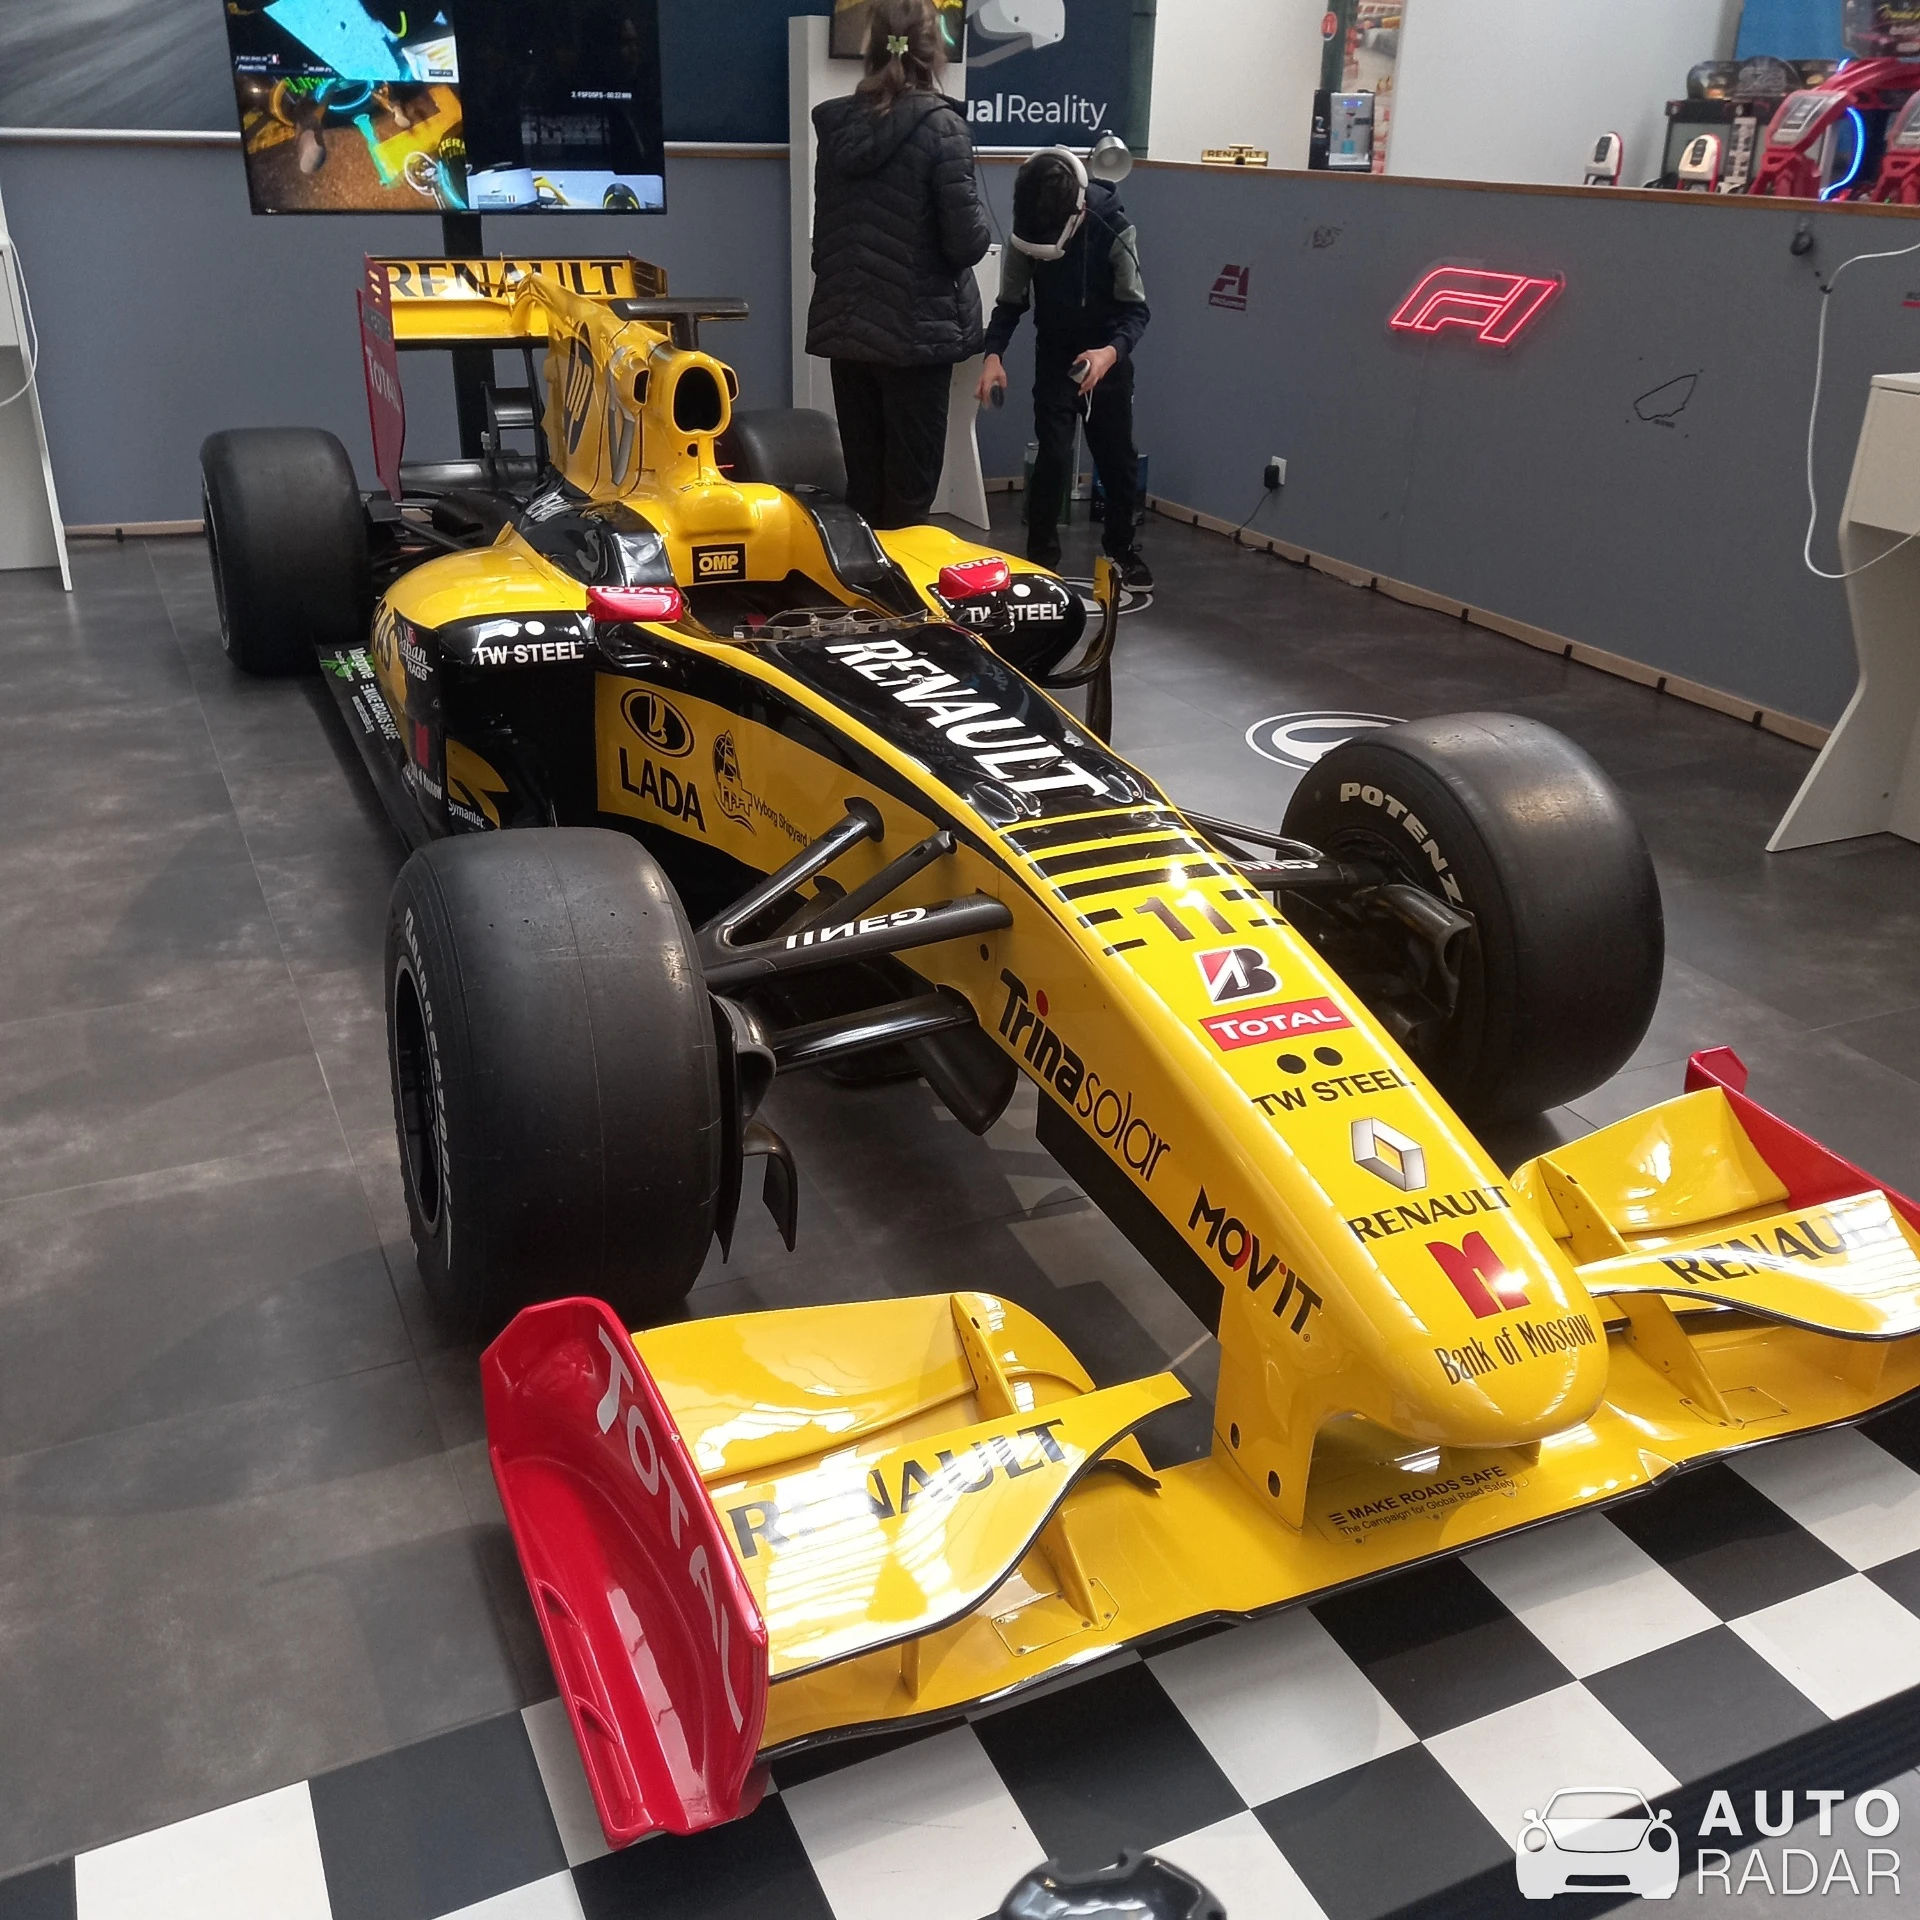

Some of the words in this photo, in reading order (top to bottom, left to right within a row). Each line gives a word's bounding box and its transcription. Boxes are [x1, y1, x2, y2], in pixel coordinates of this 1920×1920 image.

[591, 585, 674, 594] TOTAL
[699, 555, 739, 572] OMP
[407, 659, 428, 682] RAGS
[471, 645, 508, 666] TW
[514, 641, 584, 664] STEEL
[824, 639, 1111, 797] RENAULT
[618, 746, 707, 834] LADA
[753, 794, 778, 828] Vyborg
[779, 812, 808, 848] Shipyard
[1133, 889, 1238, 942] 11
[1209, 1008, 1343, 1041] TOTAL
[1250, 1087, 1308, 1117] TW
[1311, 1067, 1416, 1102] STEEL
[1346, 1185, 1512, 1244] RENAULT
[1434, 1337, 1498, 1386] Bank
[1493, 1326, 1523, 1366] of
[1515, 1313, 1597, 1358] Moscow
[1340, 1524, 1361, 1536] The
[1362, 1508, 1412, 1530] Campaign
[1411, 1505, 1426, 1516] for
[1426, 1495, 1457, 1511] Global
[1458, 1487, 1484, 1501] Road
[1484, 1478, 1516, 1494] Safety
[1347, 1496, 1400, 1520] MAKE
[1398, 1477, 1461, 1505] ROADS
[1460, 1465, 1507, 1486] SAFE
